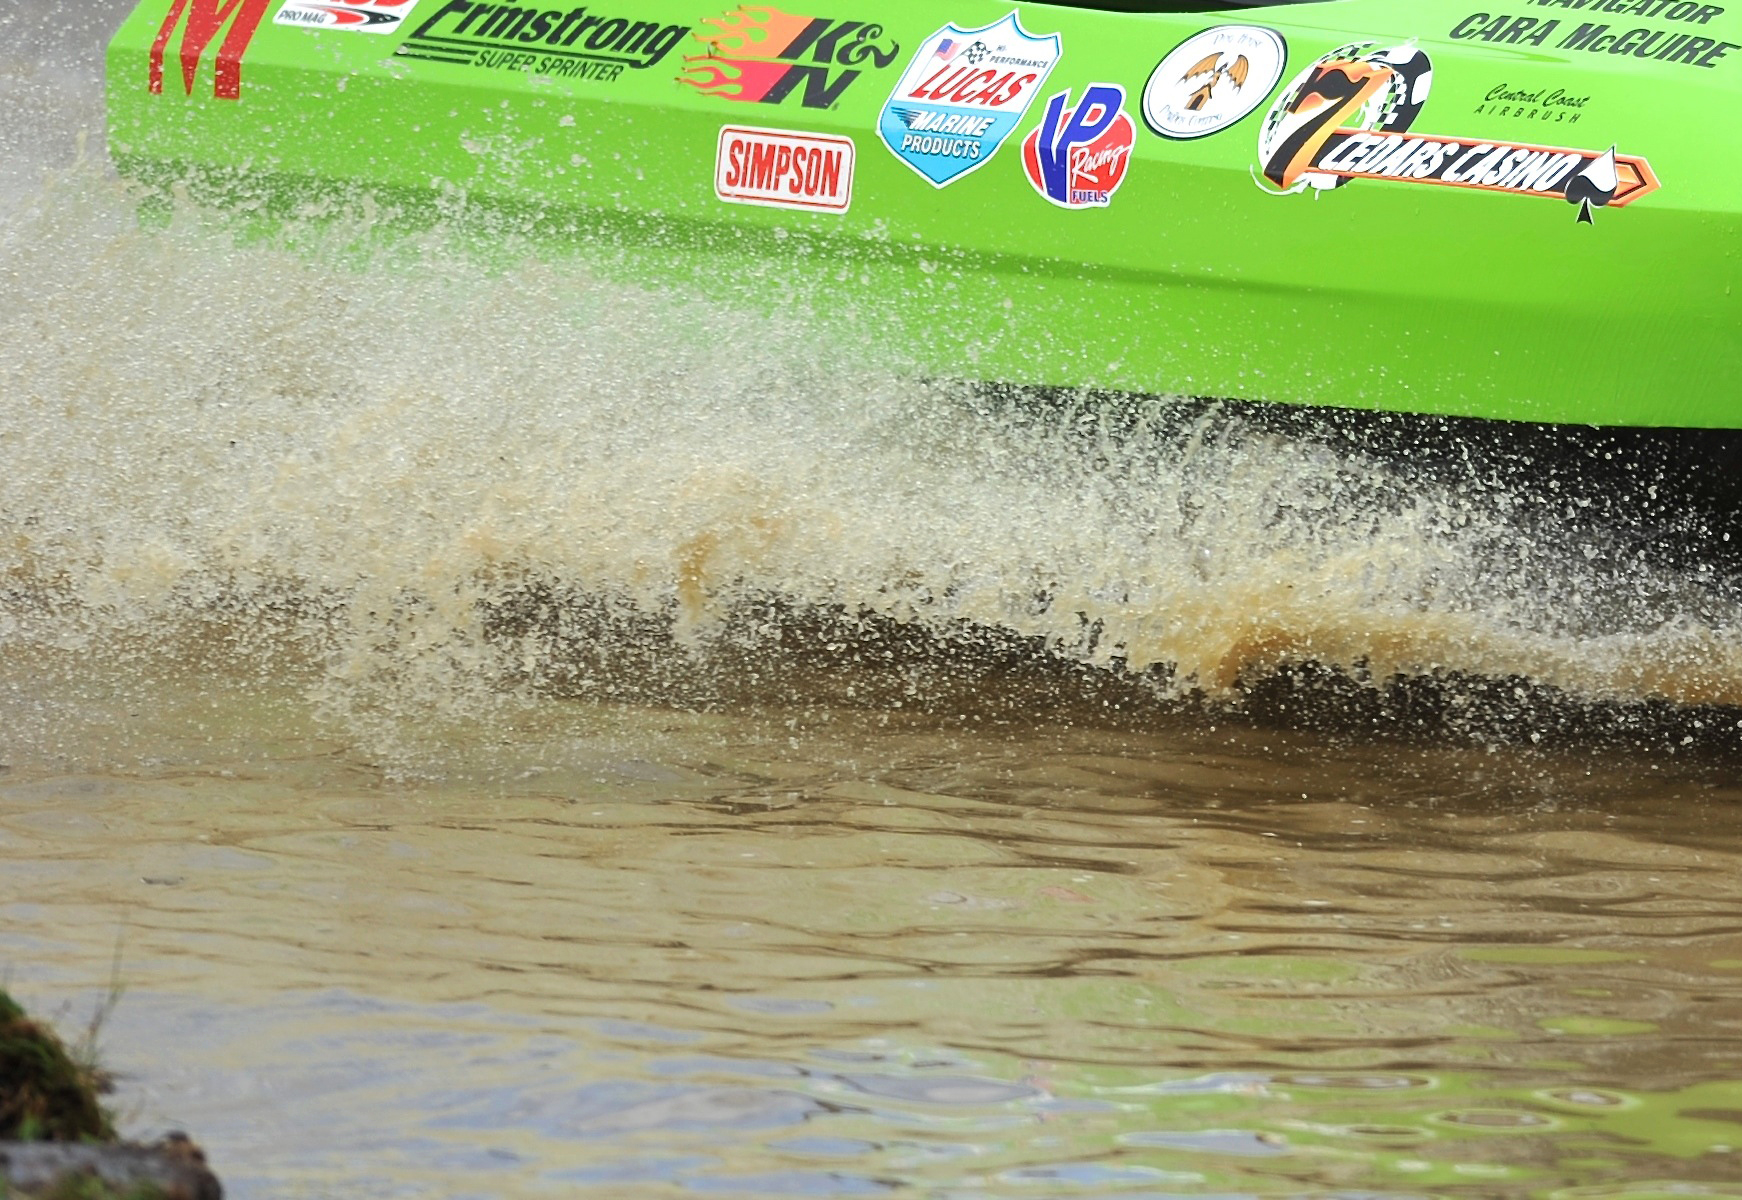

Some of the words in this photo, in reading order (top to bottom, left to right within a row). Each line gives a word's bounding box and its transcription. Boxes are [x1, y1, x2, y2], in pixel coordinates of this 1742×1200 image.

[1449, 12, 1562, 47] CARA
[1555, 22, 1742, 68] McGUIRE
[474, 50, 536, 72] SUPER
[535, 57, 624, 82] SPRINTER
[989, 55, 1049, 69] PERFORMANCE
[908, 64, 1037, 107] LUCAS
[1484, 83, 1547, 103] Central
[1542, 88, 1591, 108] Coast
[909, 109, 997, 138] MARINE
[1263, 59, 1394, 189] 7
[1473, 104, 1582, 124] AIRBRUSH
[900, 133, 982, 160] PRODUCTS
[1039, 86, 1123, 203] VP
[1071, 142, 1131, 188] Racing
[1318, 133, 1460, 179] CEDARS
[726, 139, 843, 197] SIMPSON
[1440, 143, 1583, 192] CASINO
[1072, 190, 1109, 203] FUELS
